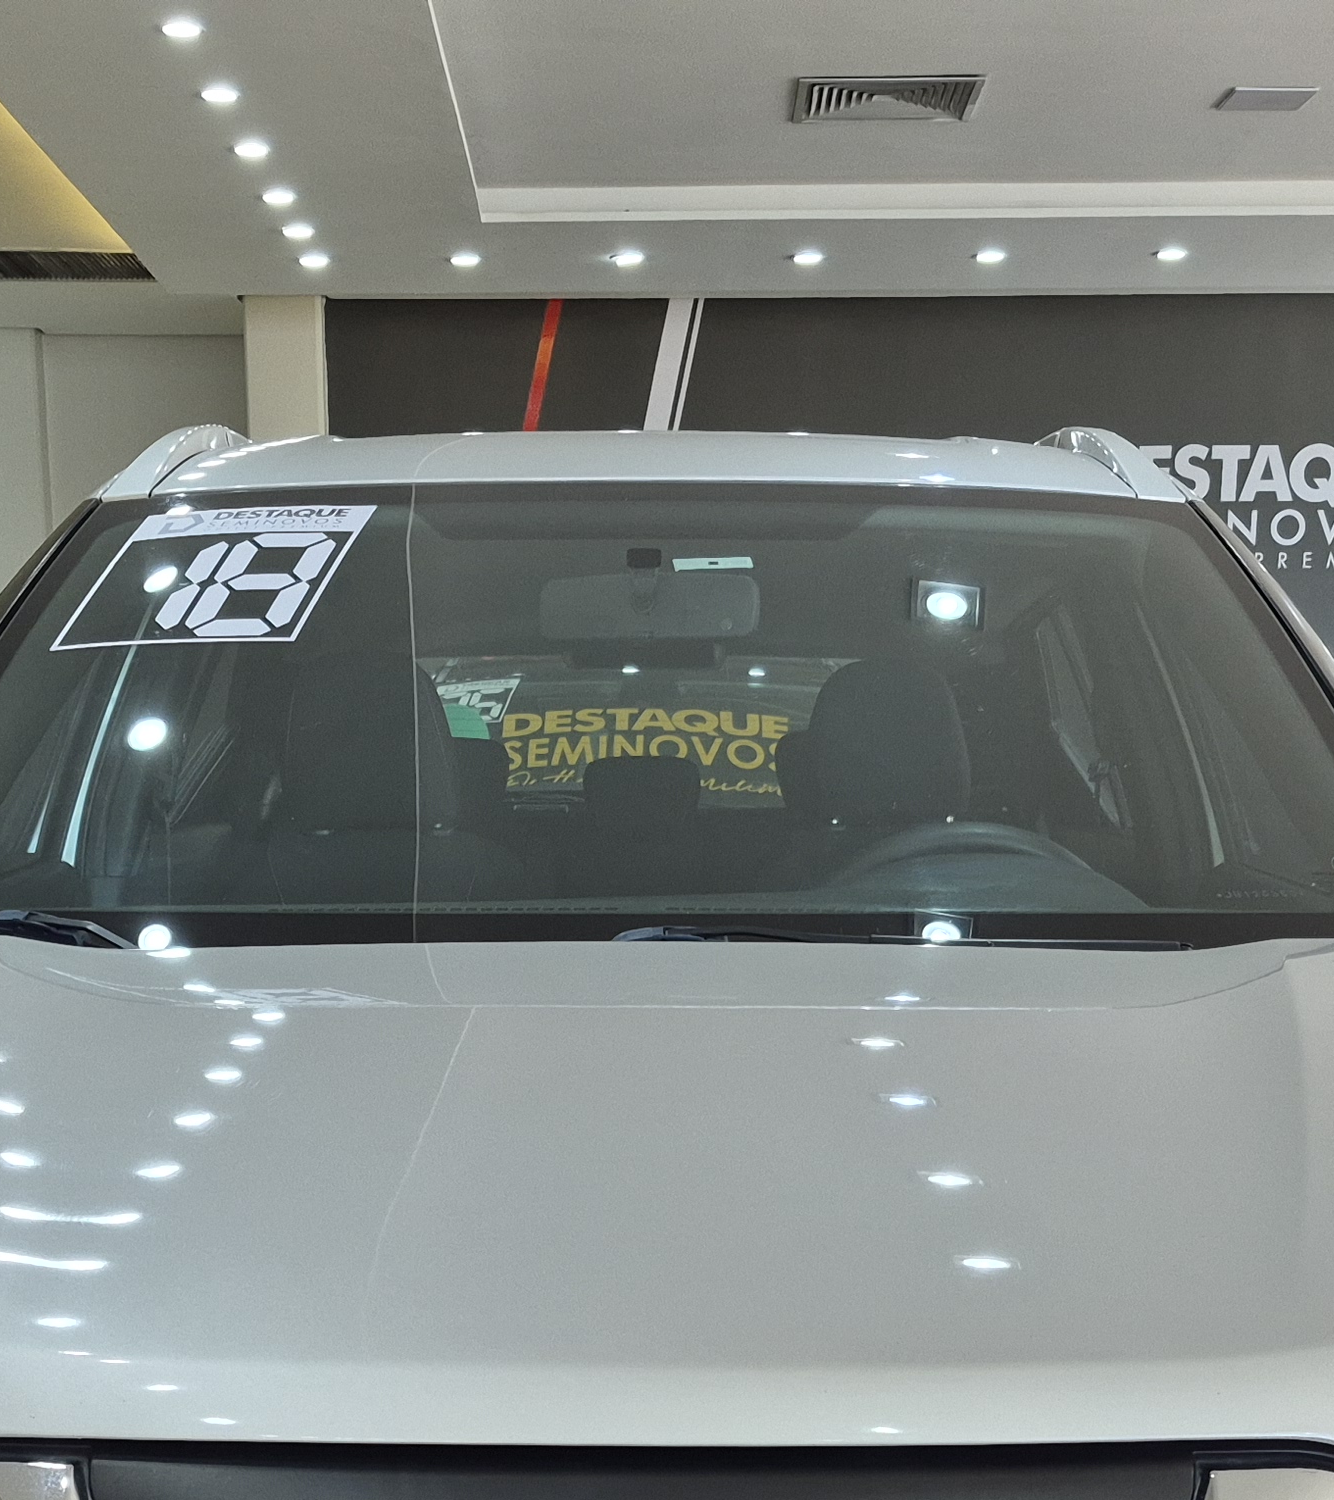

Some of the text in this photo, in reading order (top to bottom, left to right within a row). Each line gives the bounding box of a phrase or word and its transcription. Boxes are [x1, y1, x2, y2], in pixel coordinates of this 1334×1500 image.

[207, 518, 343, 527] SEMINOVOS
[213, 508, 352, 520] DESTAQUE
[155, 532, 337, 637] 18
[502, 708, 789, 740] DESTAQUE
